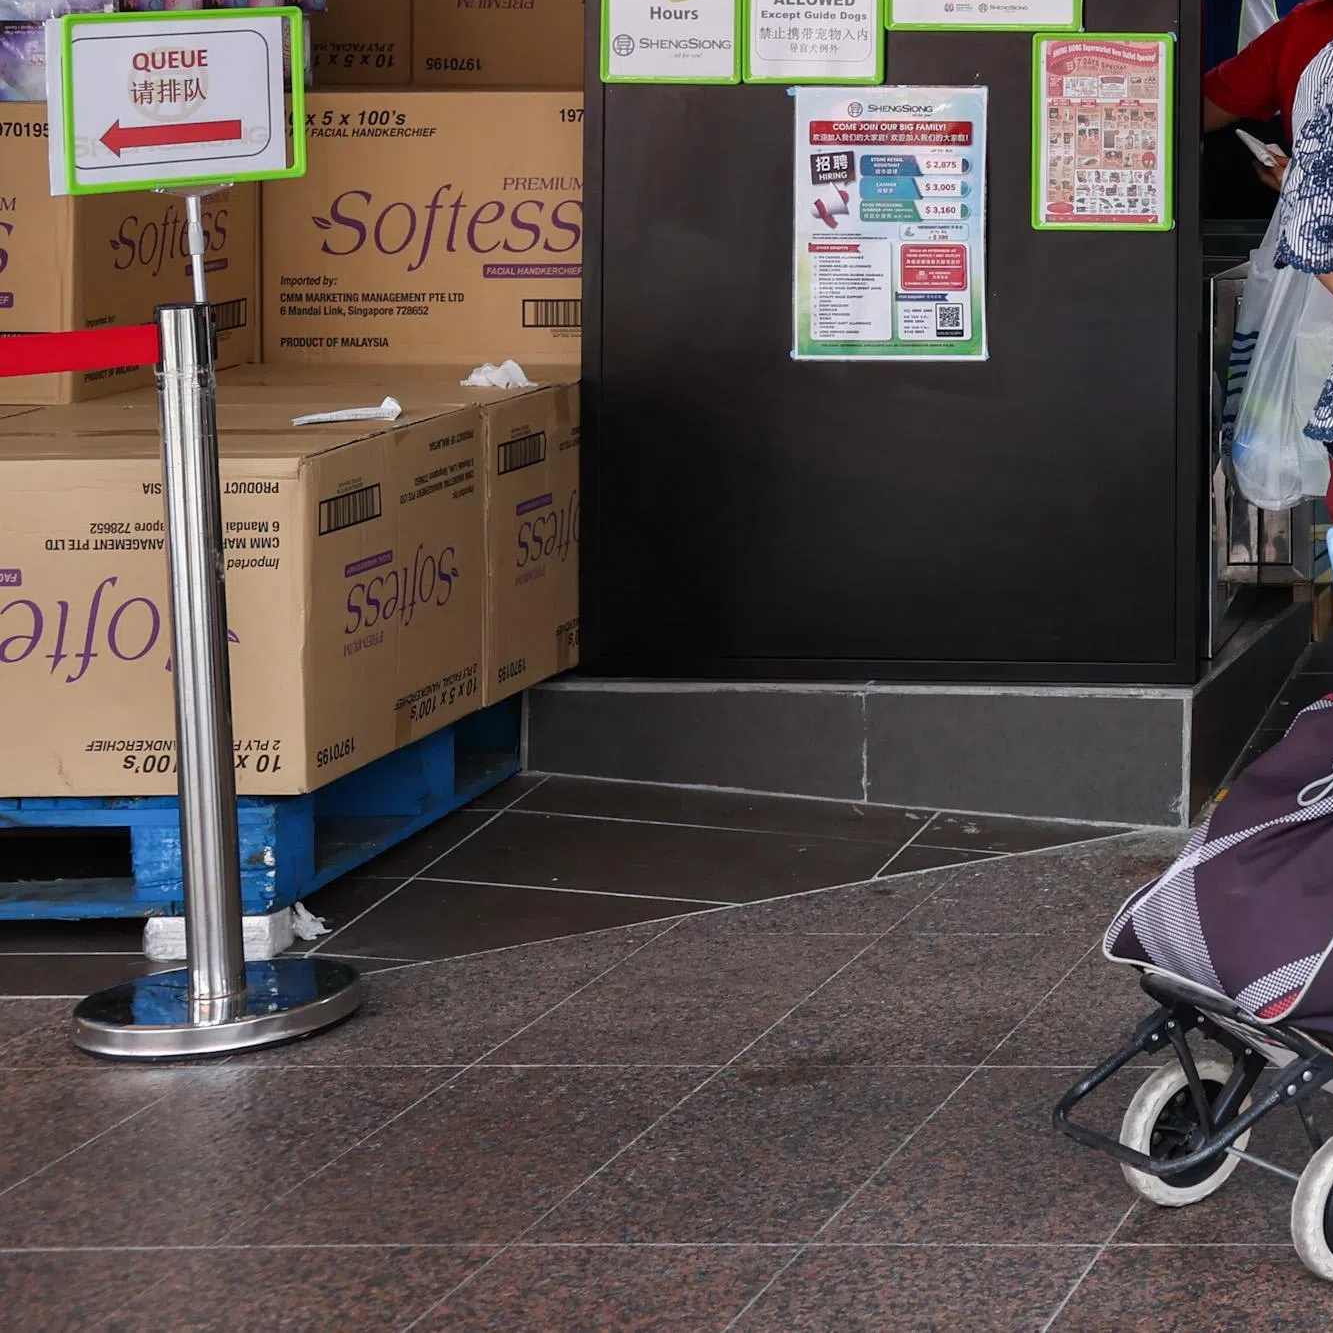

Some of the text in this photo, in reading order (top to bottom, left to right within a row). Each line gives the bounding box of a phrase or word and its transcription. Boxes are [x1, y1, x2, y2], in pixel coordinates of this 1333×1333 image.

[650, 6, 699, 21] Hours
[761, 10, 867, 21] Except Guide Dogs
[759, 26, 868, 41] 禁止携带宠物入内
[133, 49, 208, 72] QUEUE
[376, 54, 396, 68] 10
[426, 58, 482, 71] 1970195
[131, 78, 206, 105] 请排队
[322, 110, 406, 125] 5 100's
[311, 128, 436, 137] FACIAL HANDKERCHIEF
[815, 154, 848, 172] 招聘
[819, 172, 847, 181] HIRING
[321, 184, 583, 272] Softess
[486, 267, 582, 275] FACIAL HANDKERCHIEF
[280, 276, 337, 286] Imported by:
[280, 293, 464, 302] CMM MARKETING MANAGEMENT PTE LTD
[280, 306, 429, 318] 6 Mandai Link, Singapore 728652
[280, 338, 388, 347] PRODUCT OF MALAYSIA
[224, 482, 279, 494] PRODUCT
[90, 522, 269, 534] Mandai 728652
[45, 539, 65, 550] LTD
[69, 539, 89, 549] PTE
[257, 537, 280, 548] CMM
[227, 558, 279, 569] Imported
[344, 543, 456, 634] Softess
[498, 658, 526, 683] 1970195
[317, 738, 355, 768] 1970195
[256, 755, 281, 769] 10
